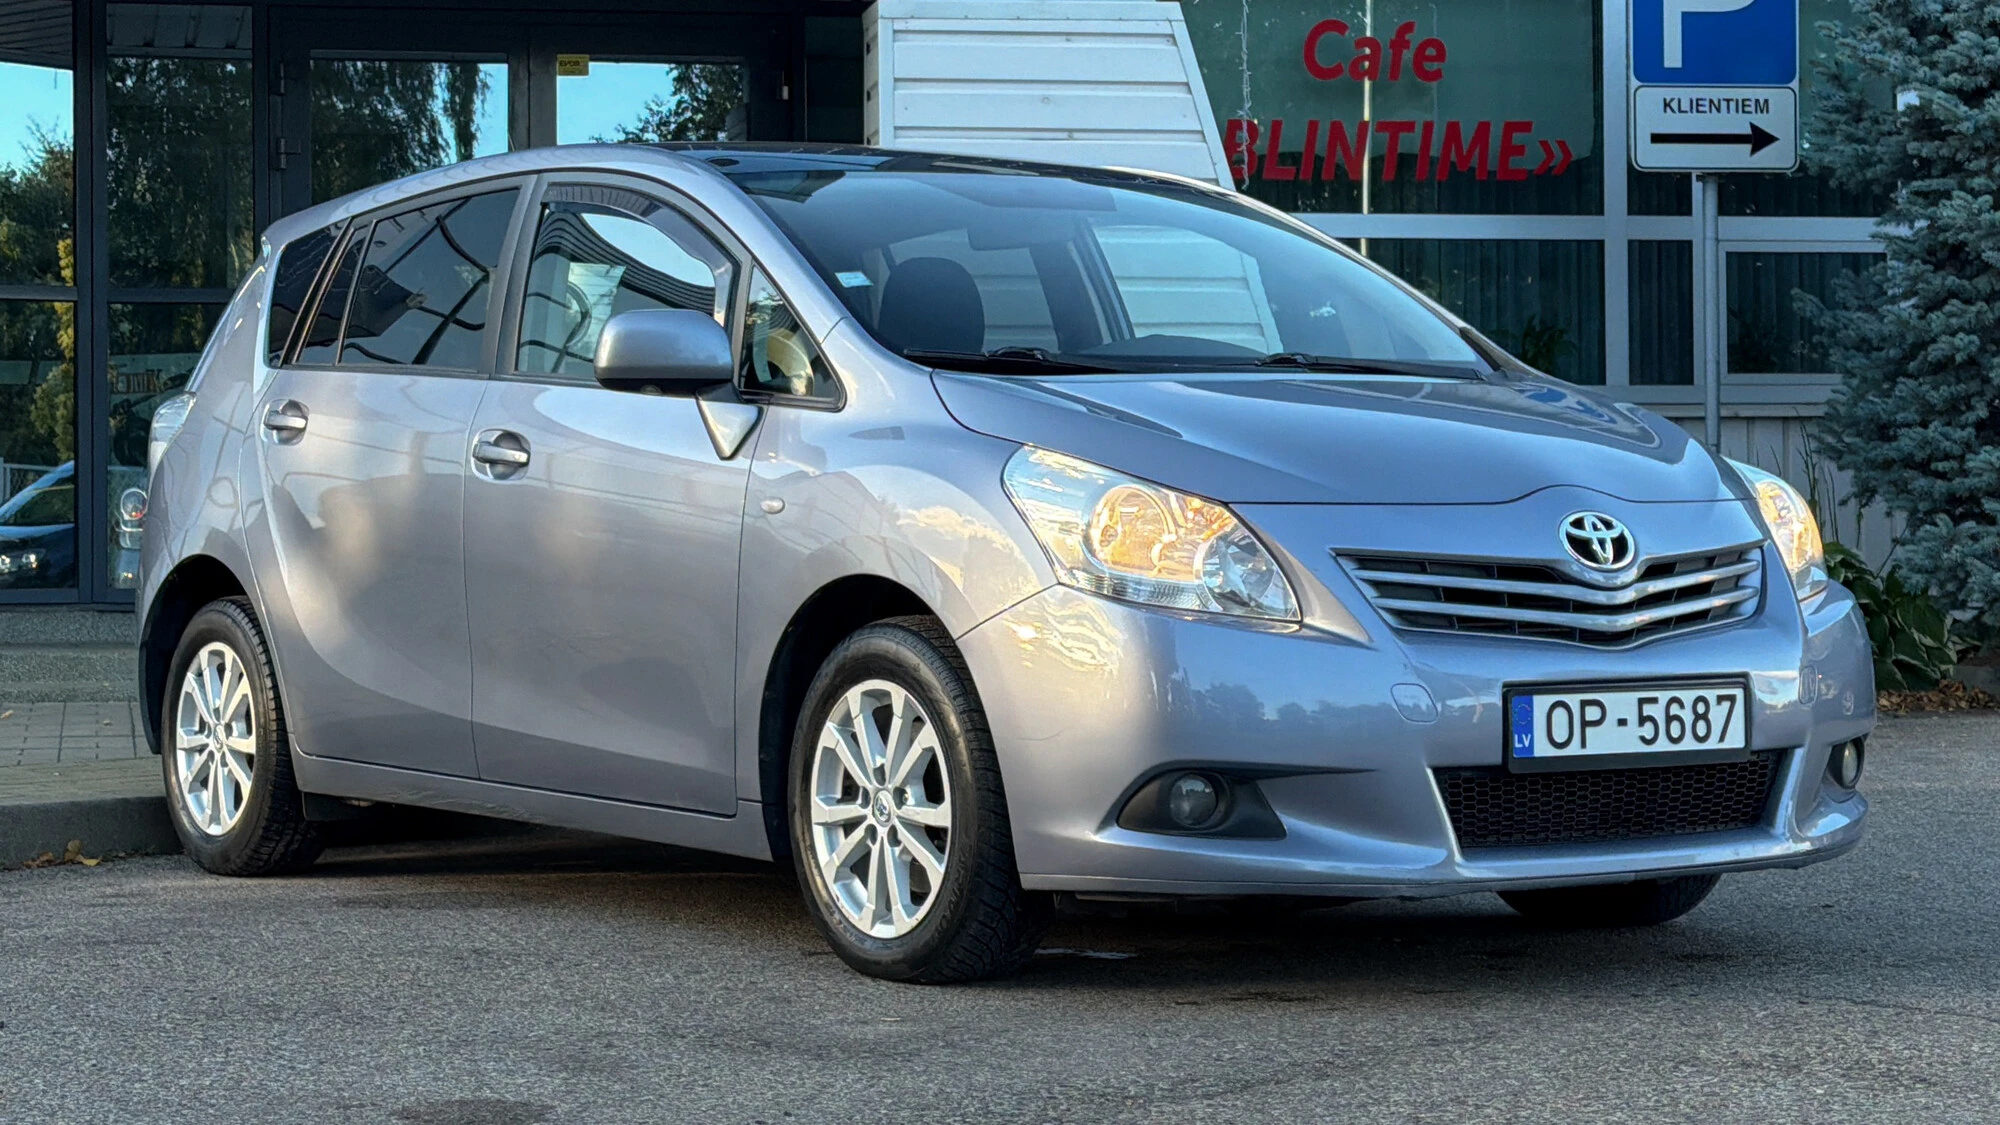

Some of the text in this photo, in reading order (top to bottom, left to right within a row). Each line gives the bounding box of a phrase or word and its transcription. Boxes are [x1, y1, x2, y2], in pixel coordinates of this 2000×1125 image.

[1303, 18, 1447, 82] Cafe
[1663, 97, 1770, 114] KLIENTIEM
[1546, 694, 1738, 750] OP-5687
[1514, 733, 1531, 748] LV
